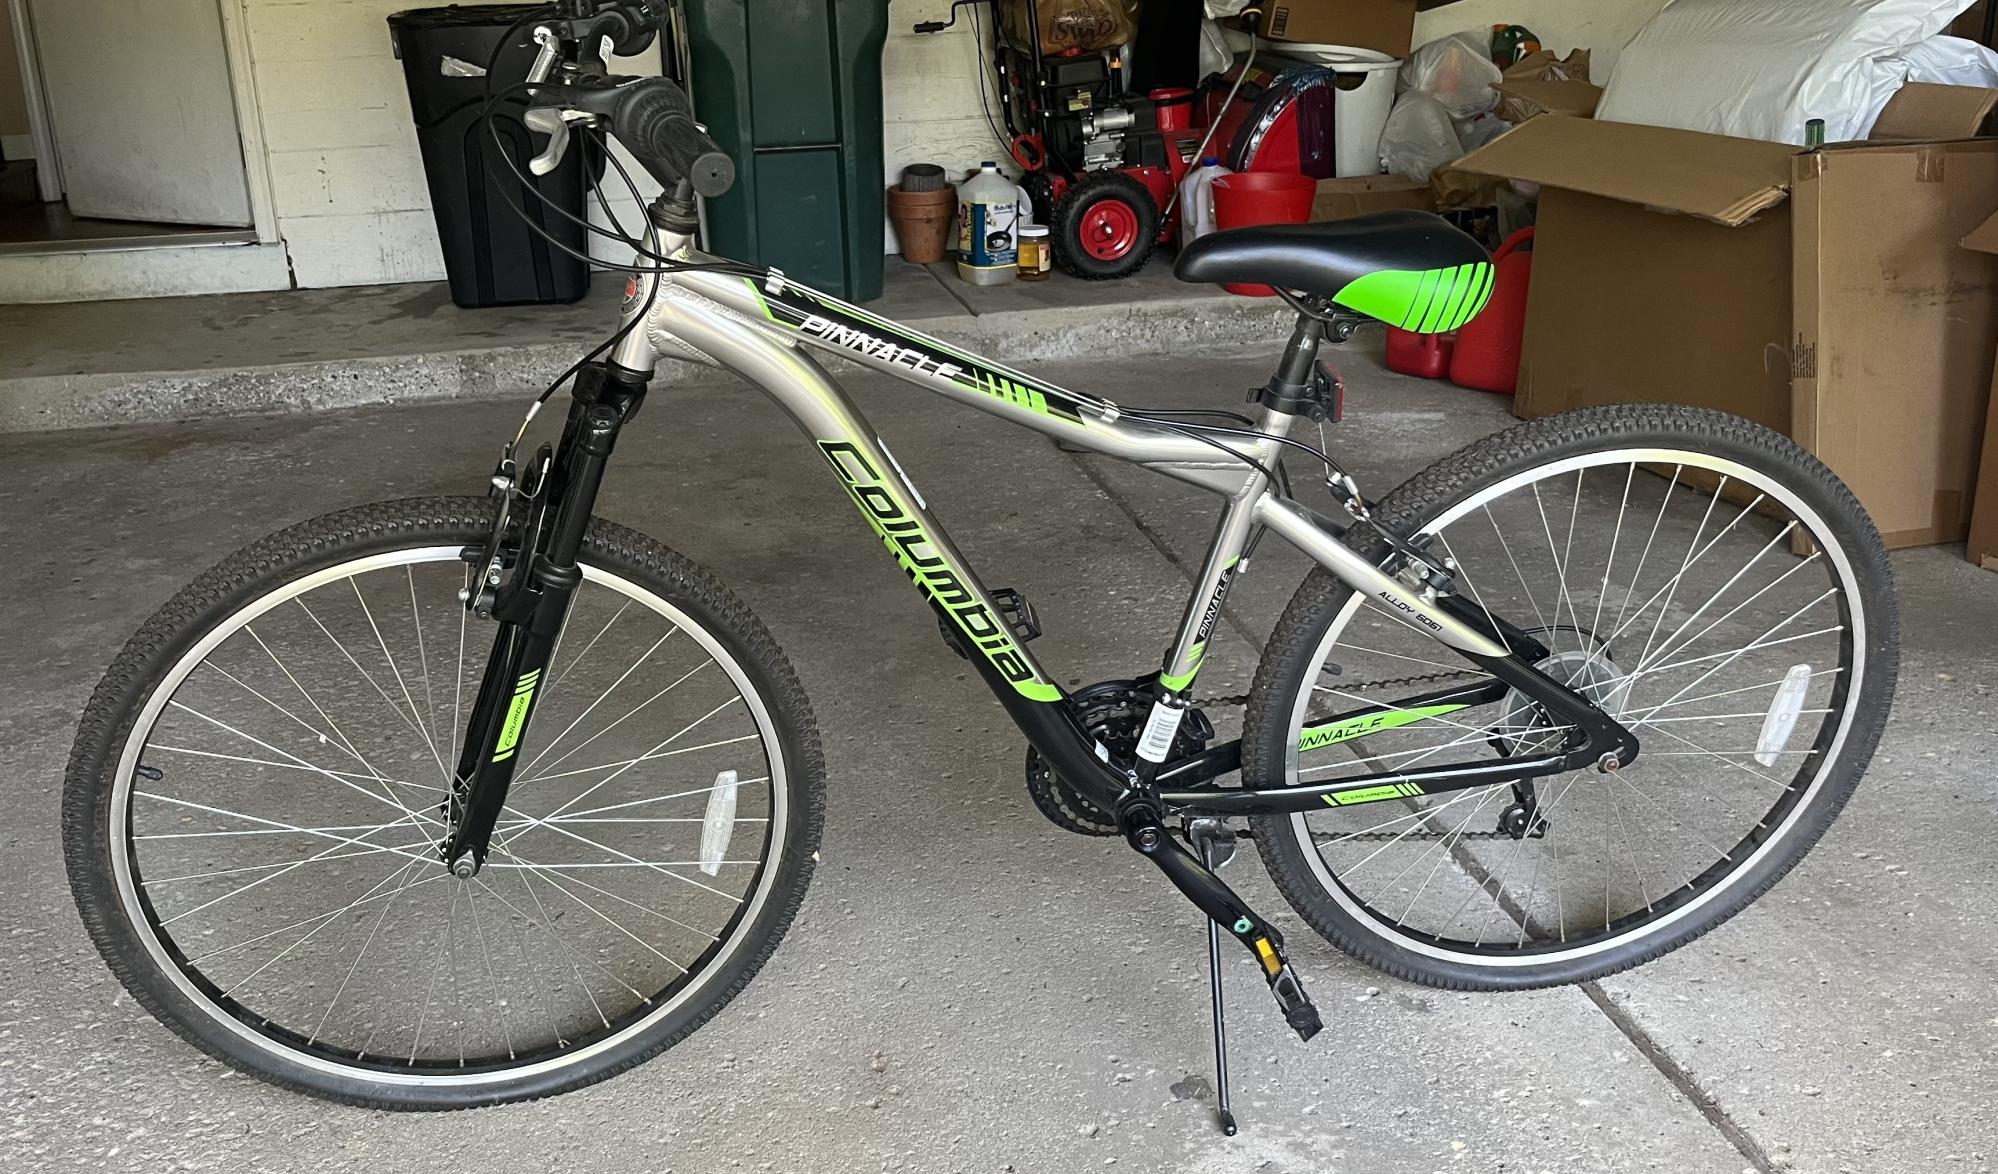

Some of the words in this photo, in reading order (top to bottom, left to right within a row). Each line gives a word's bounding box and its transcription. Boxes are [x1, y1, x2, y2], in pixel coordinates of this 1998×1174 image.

[800, 314, 963, 378] PINNACLE
[1199, 570, 1230, 638] PINNACLE
[1378, 591, 1415, 613] ALLOY
[1415, 613, 1443, 632] 6061
[1298, 717, 1385, 749] INNACLE
